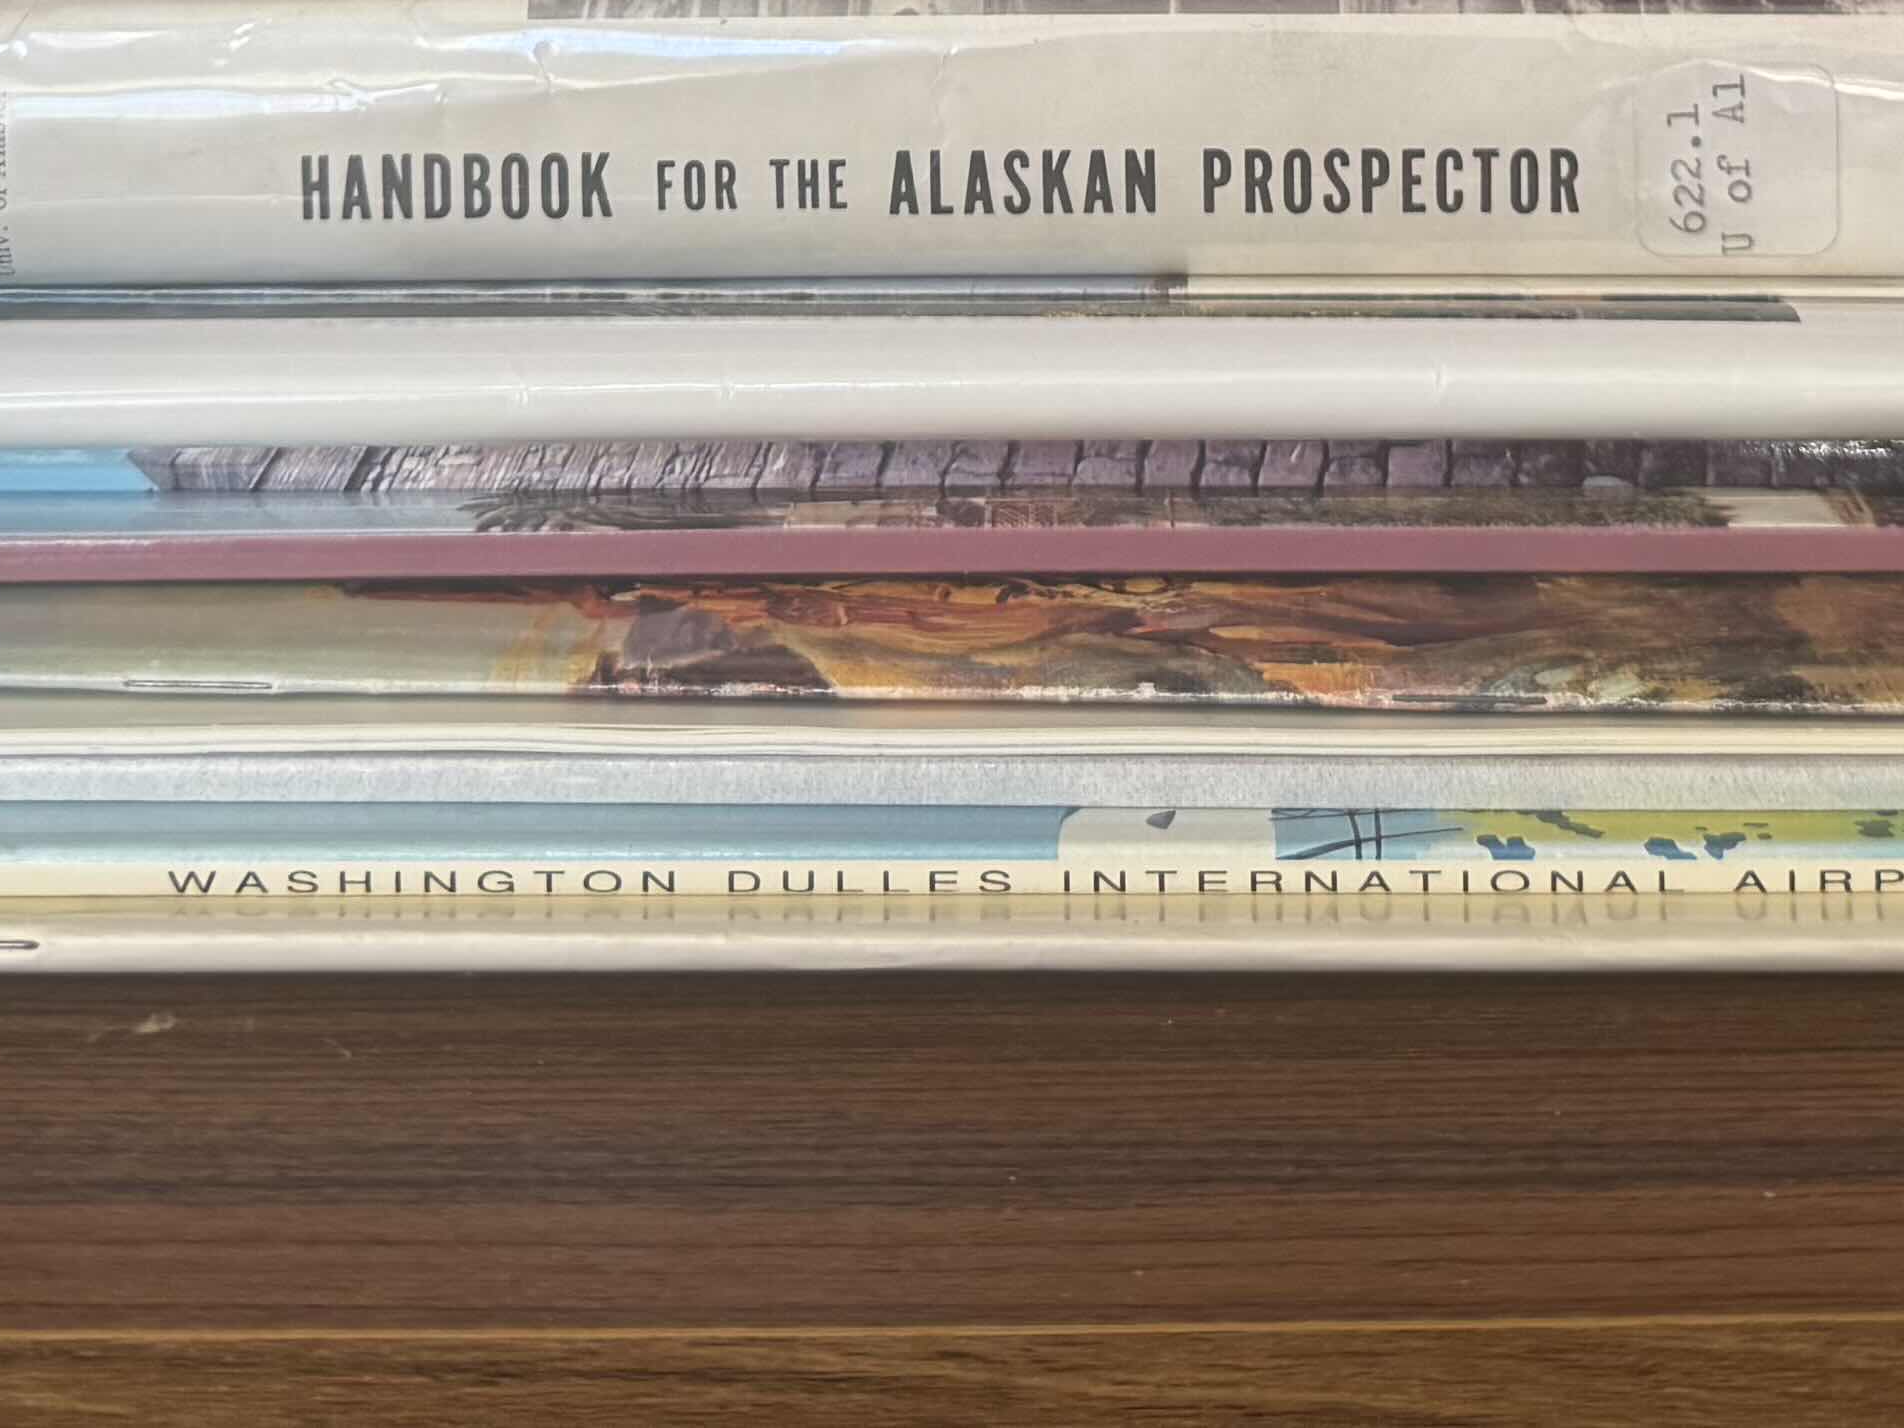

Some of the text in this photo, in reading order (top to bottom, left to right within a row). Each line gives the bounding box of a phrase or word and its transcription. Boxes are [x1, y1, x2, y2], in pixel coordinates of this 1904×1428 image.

[299, 146, 1581, 222] HANDBOOK FOR THE ALASKAN PROSPECTOR
[1666, 103, 1708, 235] 622.1
[1717, 154, 1753, 204] of
[1721, 232, 1755, 257] U
[168, 869, 680, 895] WASHINGTON
[728, 869, 1013, 895] DULLES
[1063, 867, 1689, 894] INTERNATIONAL
